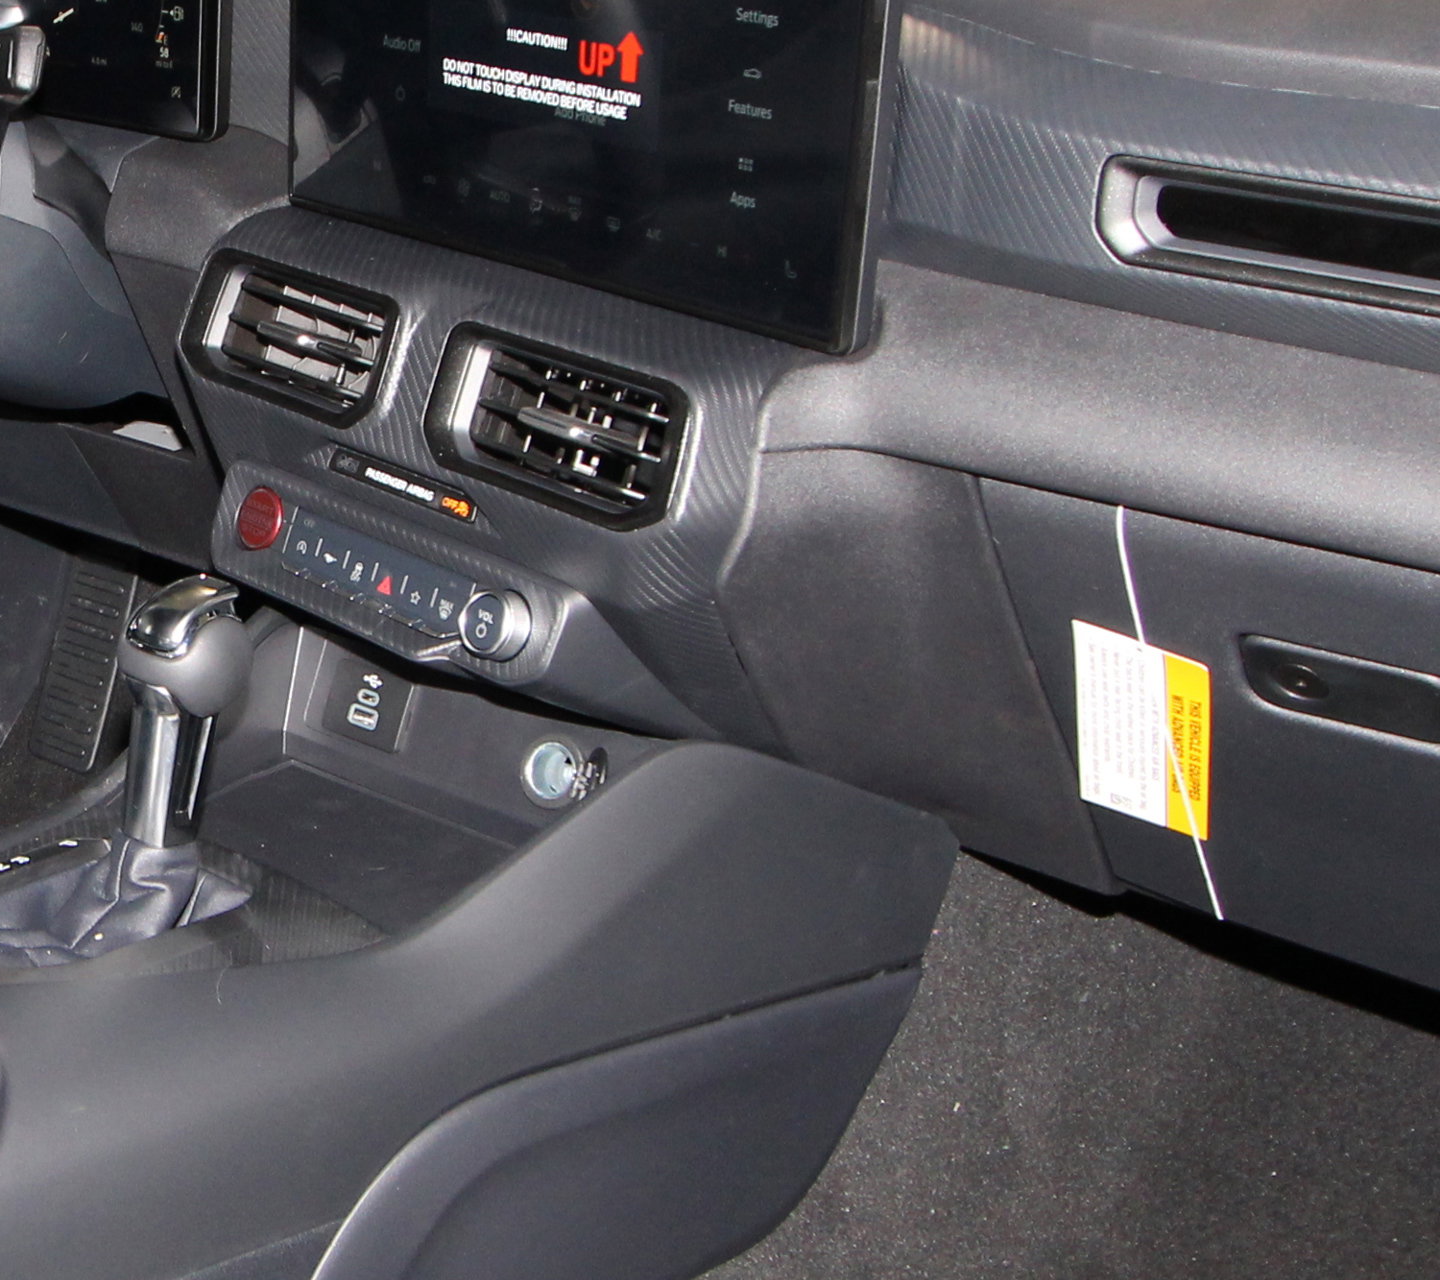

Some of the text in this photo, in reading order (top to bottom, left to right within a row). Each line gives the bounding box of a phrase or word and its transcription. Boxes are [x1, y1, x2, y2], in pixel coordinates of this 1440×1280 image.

[736, 7, 779, 28] Settings
[383, 34, 421, 53] Audio Off
[579, 40, 616, 77] UP
[443, 58, 641, 108] DO NOT TOUCH DISPLAY DURING INSTALLATION
[443, 72, 462, 87] THIS
[462, 76, 481, 91] FILM
[482, 79, 491, 93] IS
[492, 81, 504, 95] TO
[504, 84, 516, 98] BE
[517, 86, 559, 107] REMOVED
[560, 94, 595, 115] BEFORE
[728, 99, 773, 120] Features
[730, 191, 756, 209] Apps
[478, 609, 494, 624] VOL
